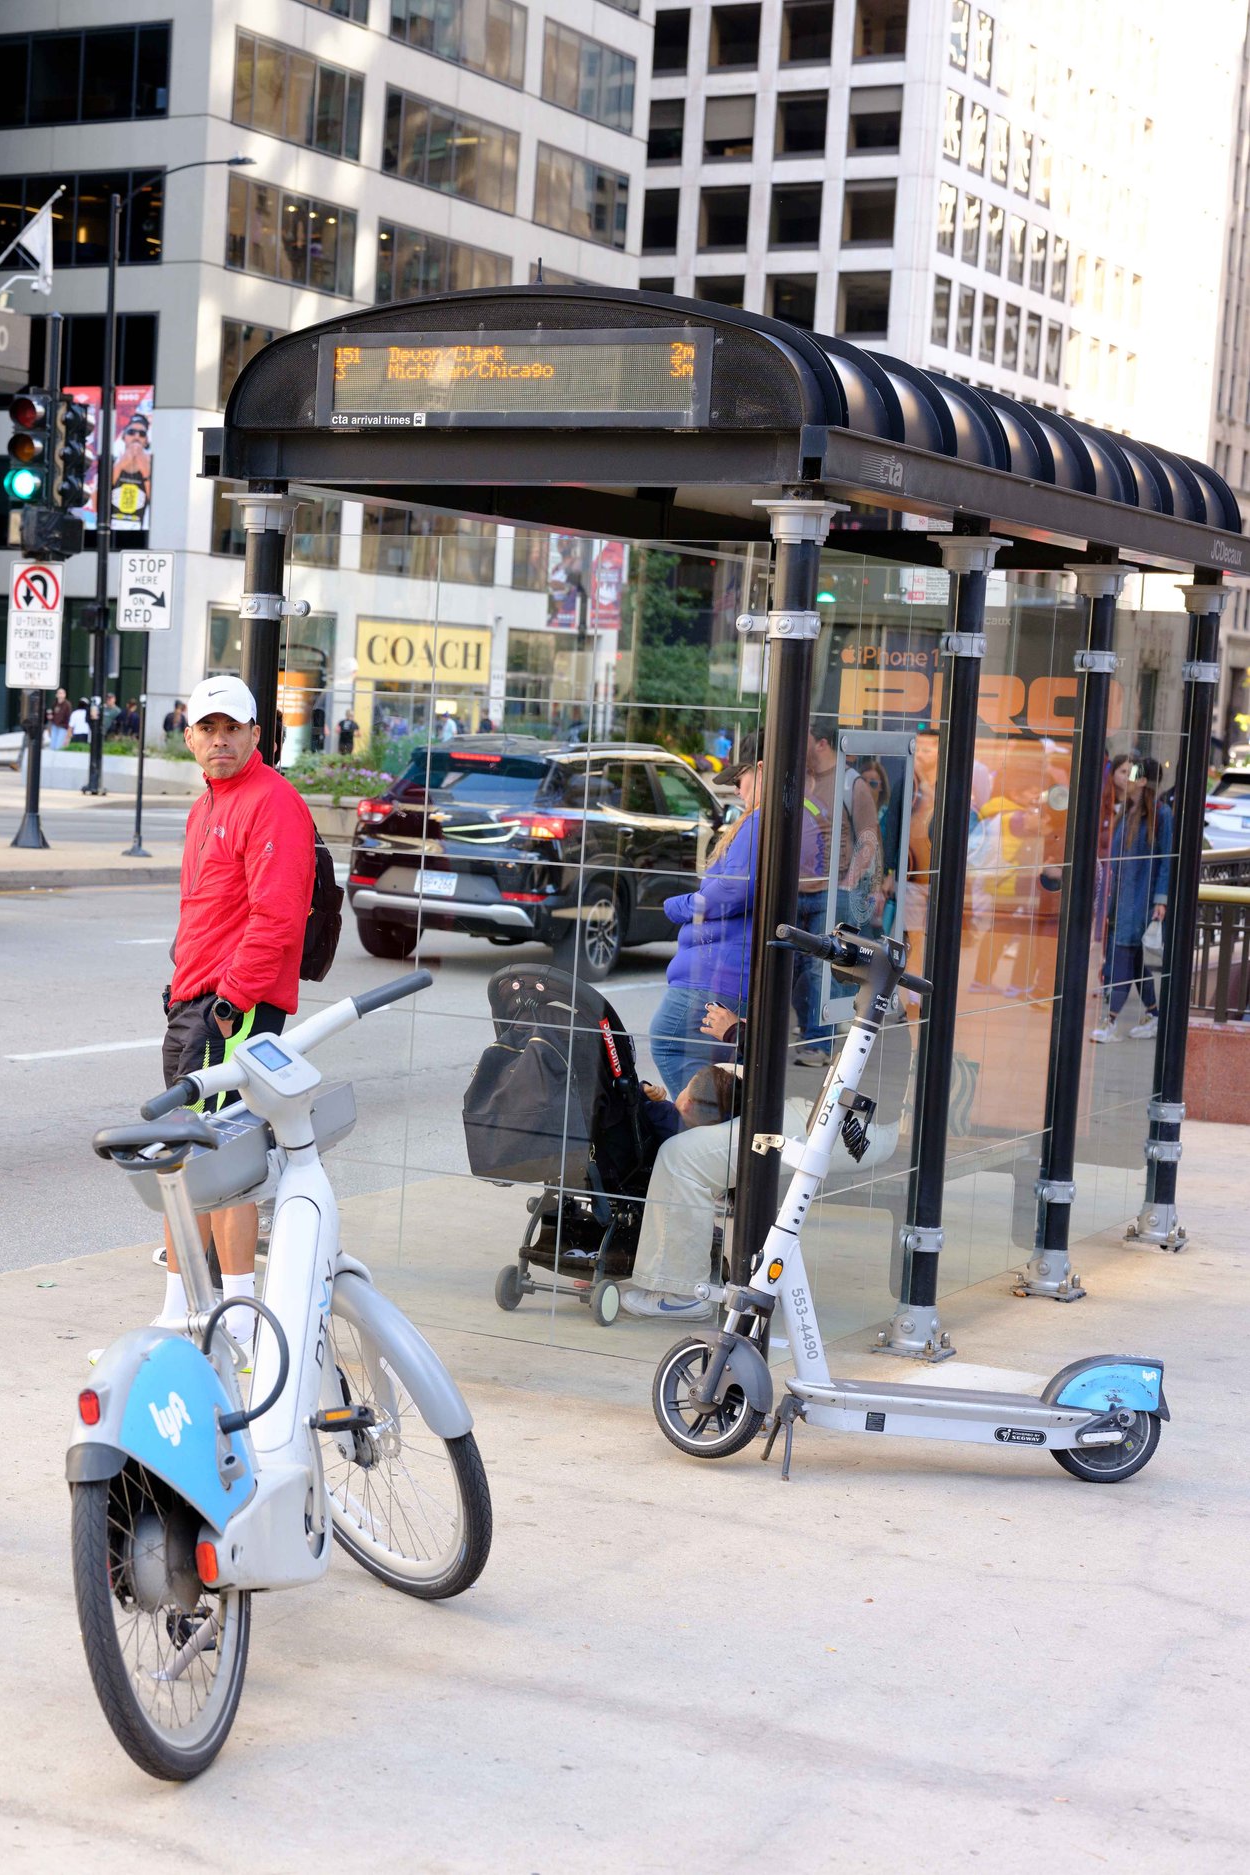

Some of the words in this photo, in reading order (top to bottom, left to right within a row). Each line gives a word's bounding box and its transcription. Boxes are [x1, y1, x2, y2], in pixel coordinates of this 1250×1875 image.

[335, 347, 361, 363] 151
[671, 342, 695, 359] 2m
[336, 363, 347, 380] 3
[670, 360, 694, 377] 3m
[332, 414, 348, 424] cta
[351, 415, 381, 425] arrival
[384, 415, 411, 425] times
[1210, 539, 1243, 567] JCDecaux
[128, 558, 167, 573] STOP
[134, 575, 158, 585] HERE
[132, 596, 146, 606] ON
[16, 616, 53, 627] U-TURNS
[123, 608, 152, 623] RED
[13, 628, 55, 640] PERMITTED
[27, 641, 41, 650] FOR
[14, 651, 52, 660] EMERGENCY
[366, 634, 483, 671] COACH
[857, 644, 929, 668] iPhone
[18, 662, 49, 671] VEHICLES
[24, 672, 42, 681] ONLY
[859, 946, 874, 957] DIVVY
[791, 1287, 819, 1360] 553-4490
[1142, 1370, 1157, 1382] lyft
[148, 1391, 193, 1447] lyft
